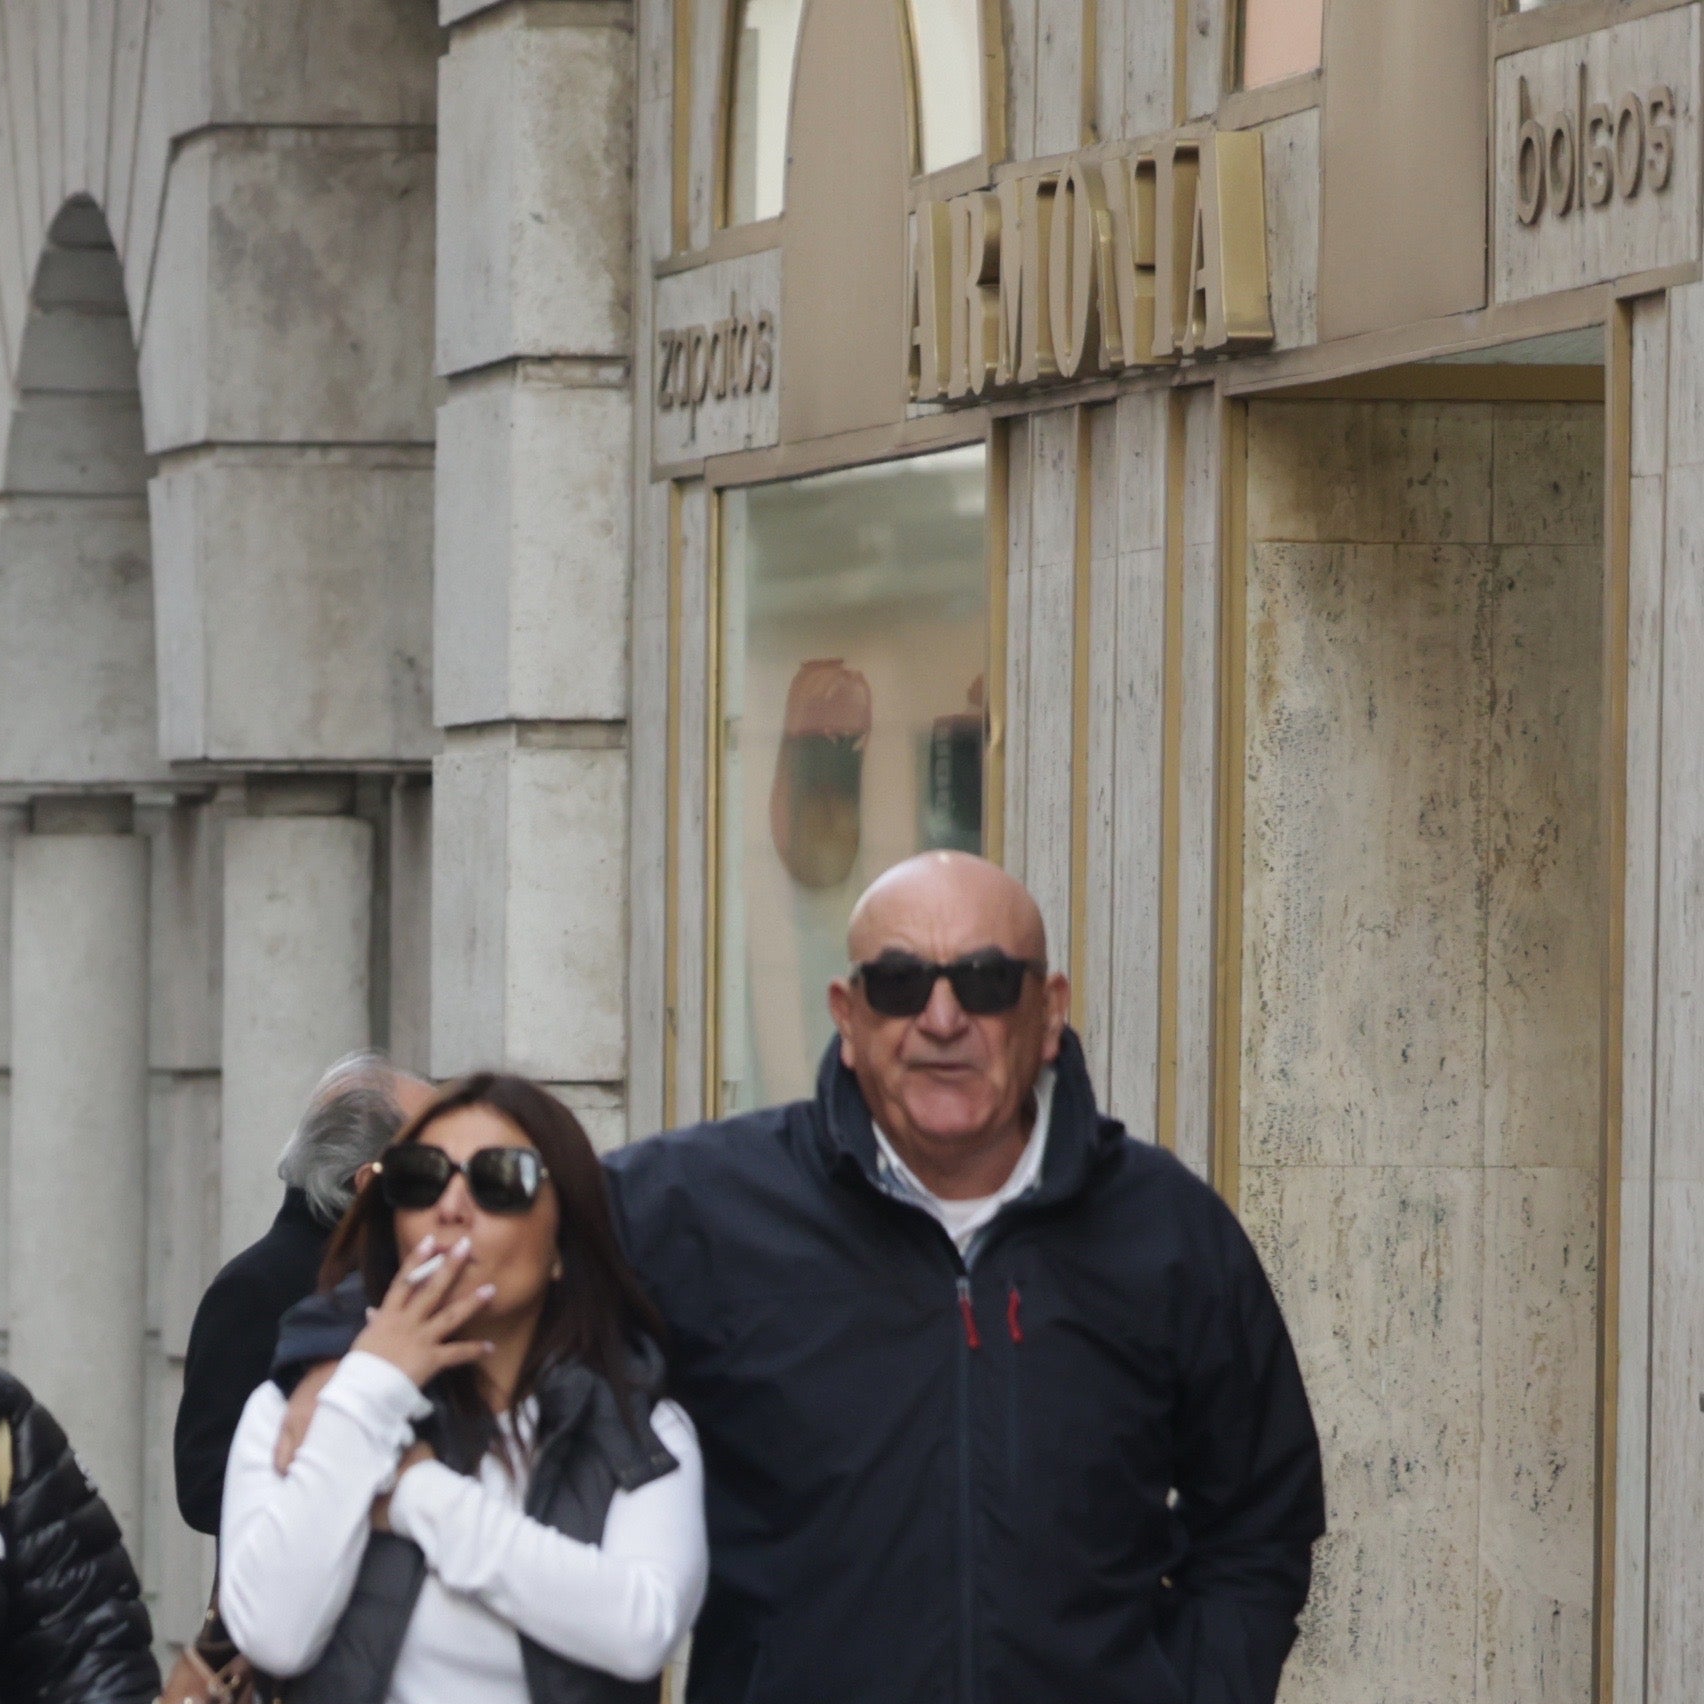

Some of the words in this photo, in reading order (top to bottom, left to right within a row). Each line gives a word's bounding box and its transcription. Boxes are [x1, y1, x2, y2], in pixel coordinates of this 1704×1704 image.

[1517, 62, 1676, 227] bolsos
[908, 132, 1274, 400] ARMONIA
[658, 291, 774, 442] zapatos
